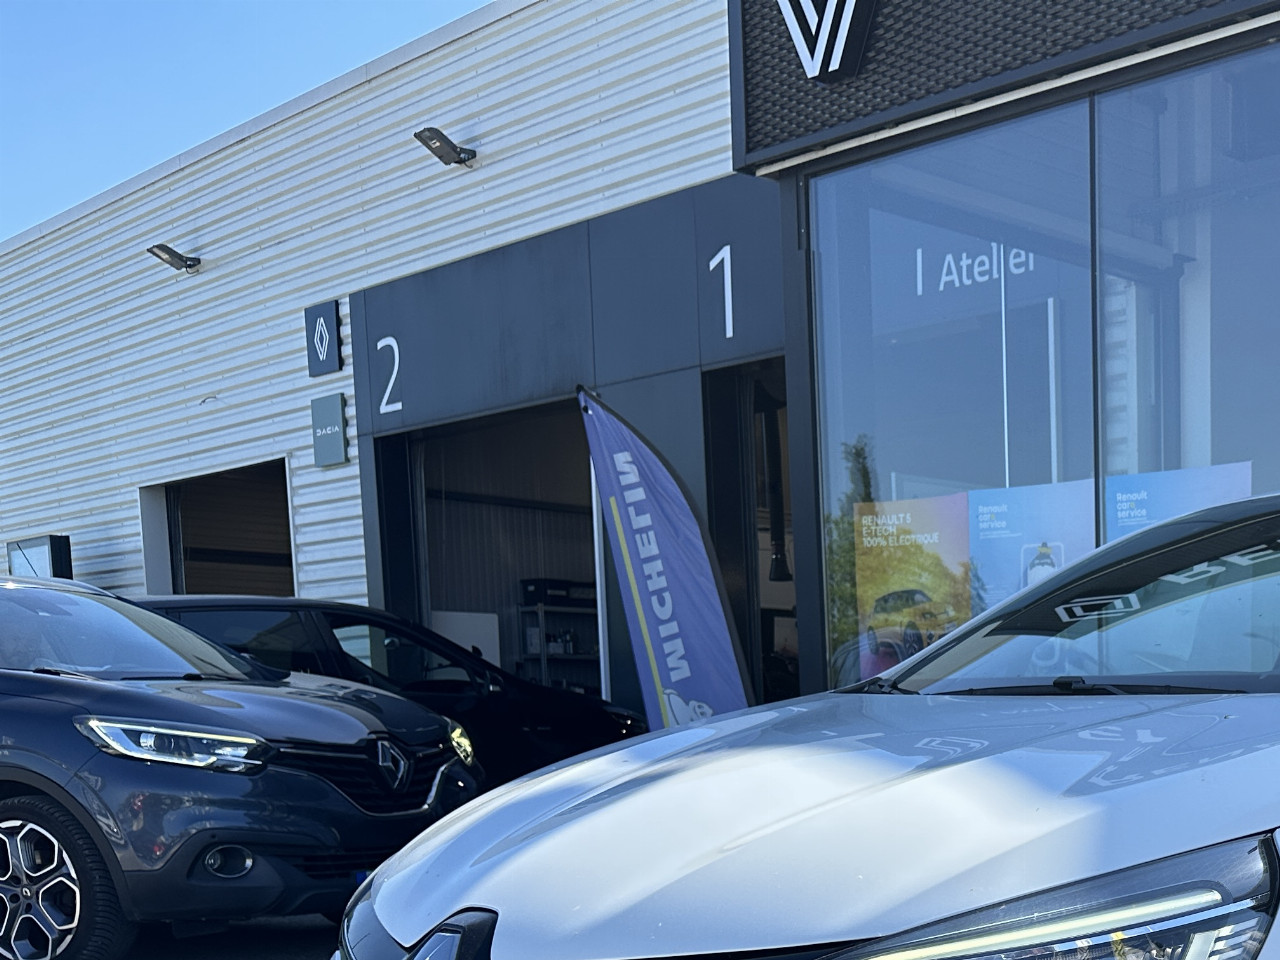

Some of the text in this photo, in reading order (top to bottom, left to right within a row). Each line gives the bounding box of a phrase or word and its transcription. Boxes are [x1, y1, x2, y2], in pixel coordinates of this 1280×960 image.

[939, 241, 1035, 292] Atele
[708, 245, 734, 338] 1
[376, 336, 402, 414] 2
[316, 425, 340, 437] DACIA
[1116, 490, 1148, 501] Renault
[978, 504, 1008, 513] Renault
[1117, 508, 1147, 518] service
[862, 513, 905, 526] RENAULT
[862, 525, 897, 537] E-TECH
[863, 536, 887, 548] 100%
